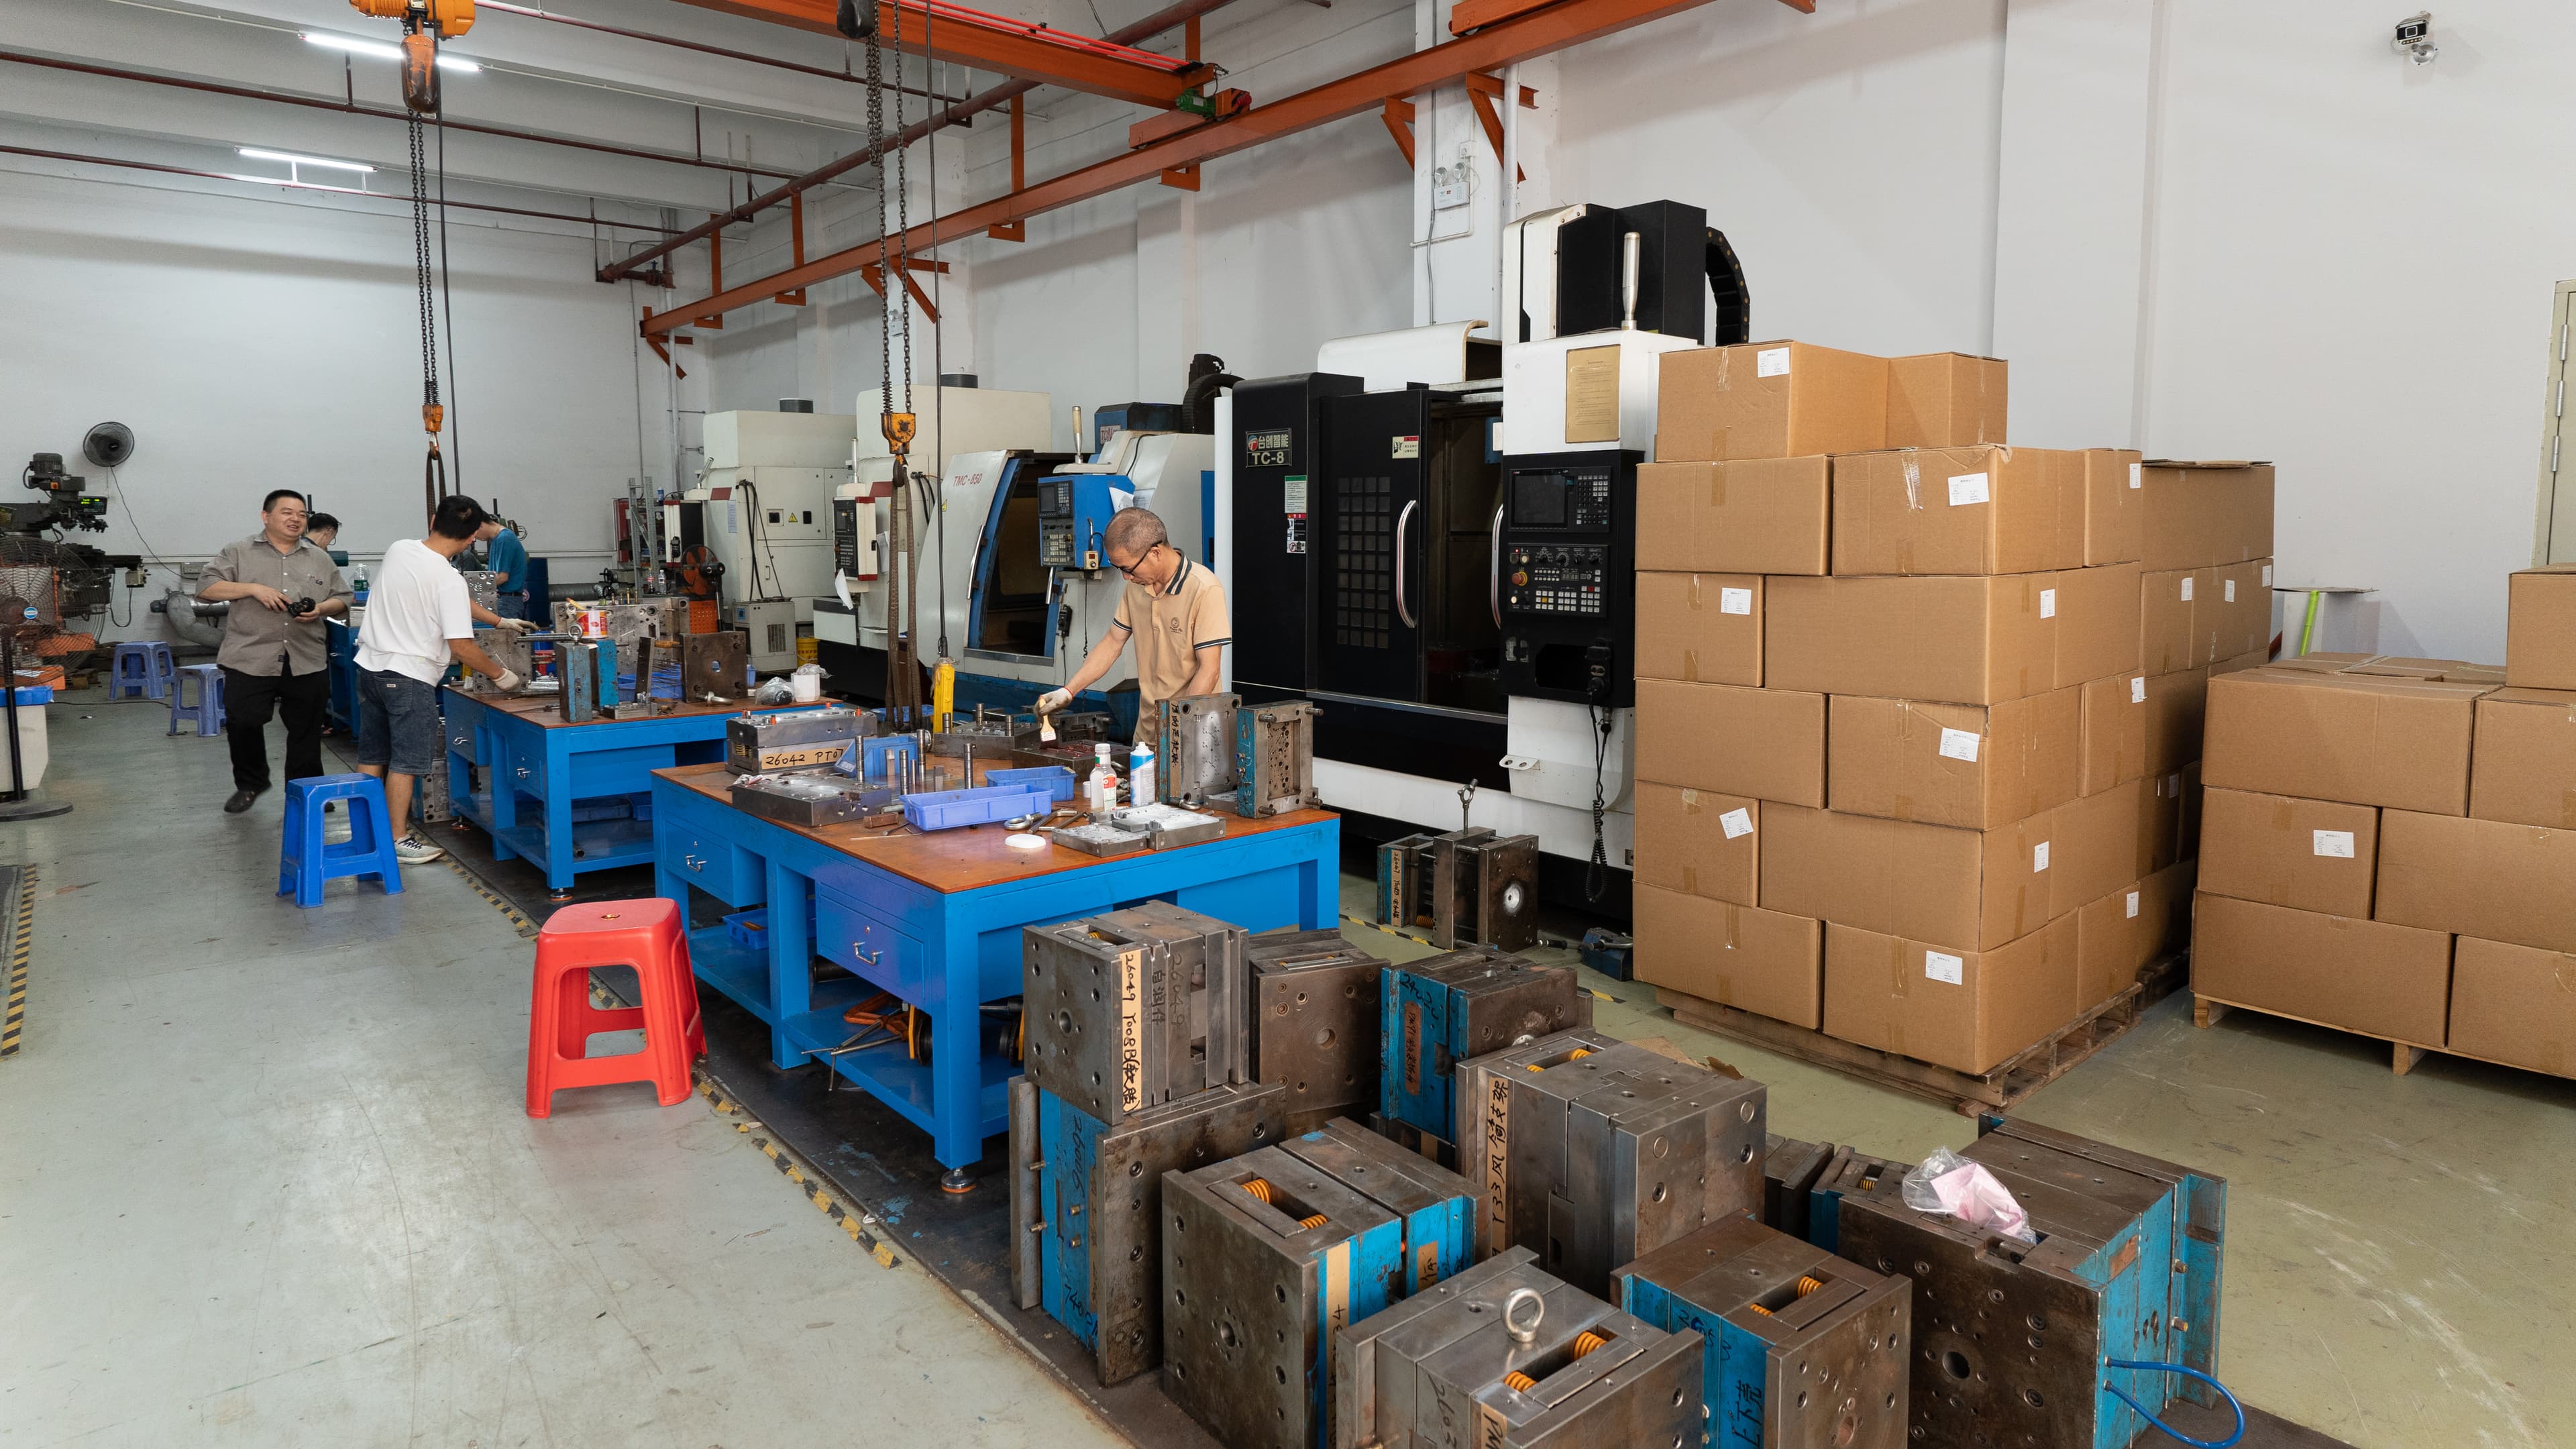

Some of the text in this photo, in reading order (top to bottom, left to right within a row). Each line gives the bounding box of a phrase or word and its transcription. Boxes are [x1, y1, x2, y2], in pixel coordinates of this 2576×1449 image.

[1258, 433, 1289, 449] 台创智能
[1252, 451, 1285, 465] TC-8
[765, 753, 806, 766] 26042
[1122, 955, 1136, 1001] 26049
[1170, 953, 1185, 1028] 26049
